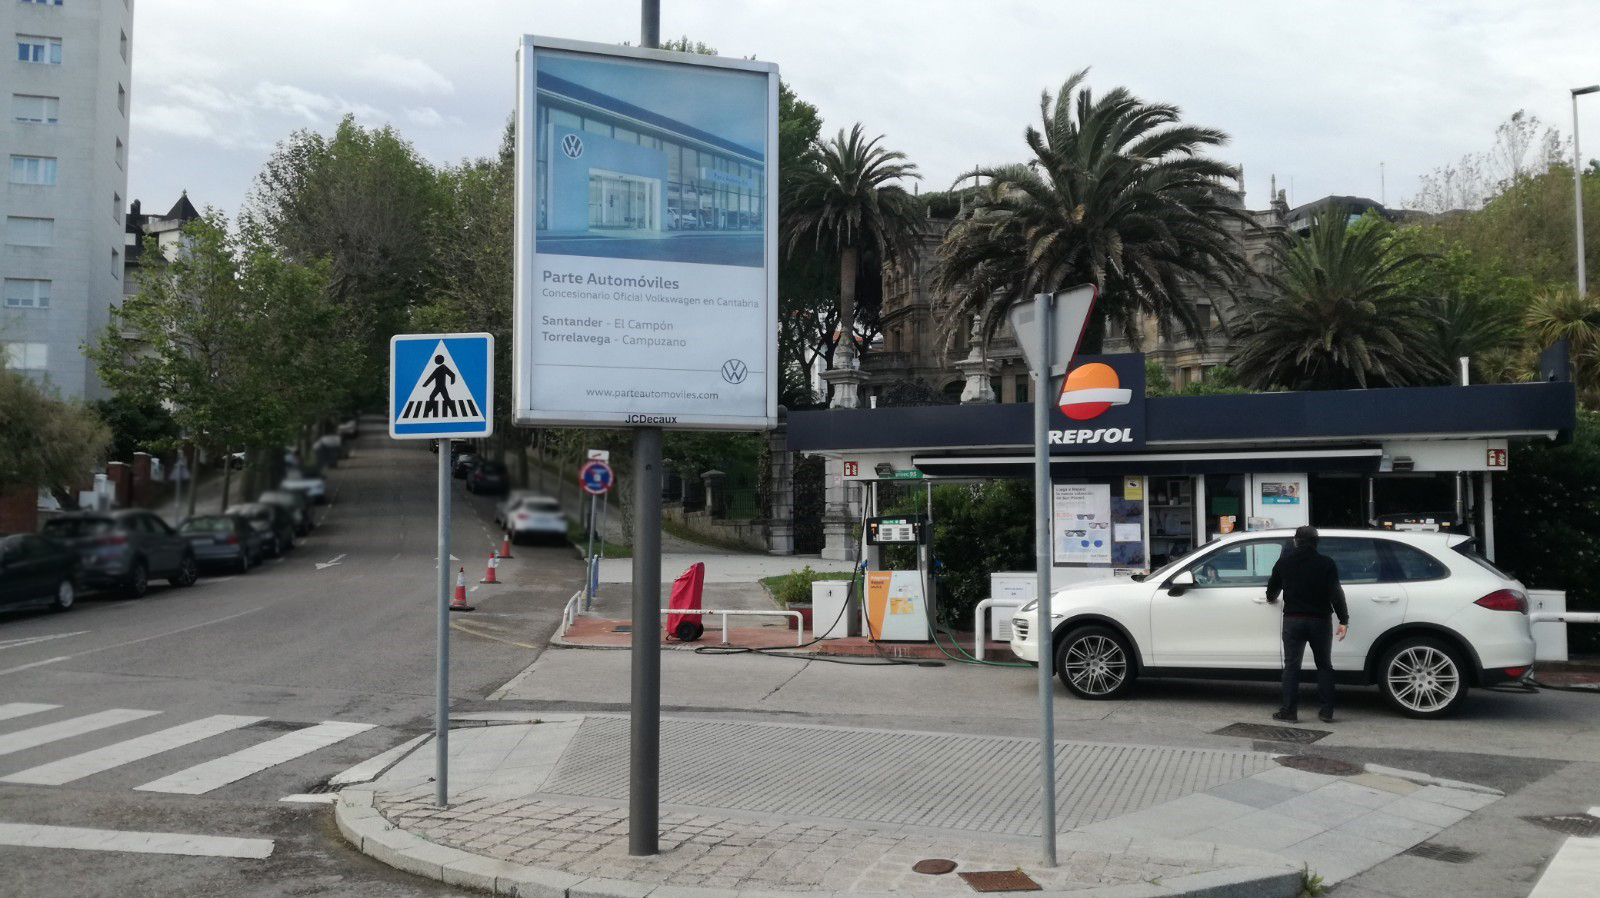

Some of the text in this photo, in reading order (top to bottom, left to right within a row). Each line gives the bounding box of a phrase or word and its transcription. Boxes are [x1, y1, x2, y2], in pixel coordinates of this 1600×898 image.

[543, 270, 679, 291] Parte Automóviles
[542, 288, 759, 309] Concesionario Oficial Volkswagen en Cantabria
[542, 315, 603, 328] Santander
[615, 318, 624, 329] El
[628, 319, 674, 333] Campón
[542, 332, 610, 345] Torrelavega
[622, 335, 686, 348] Campuzano
[586, 387, 718, 400] www.parteautomoviles.com
[625, 414, 677, 424] JCDecaux
[1048, 428, 1133, 444] REPSOL
